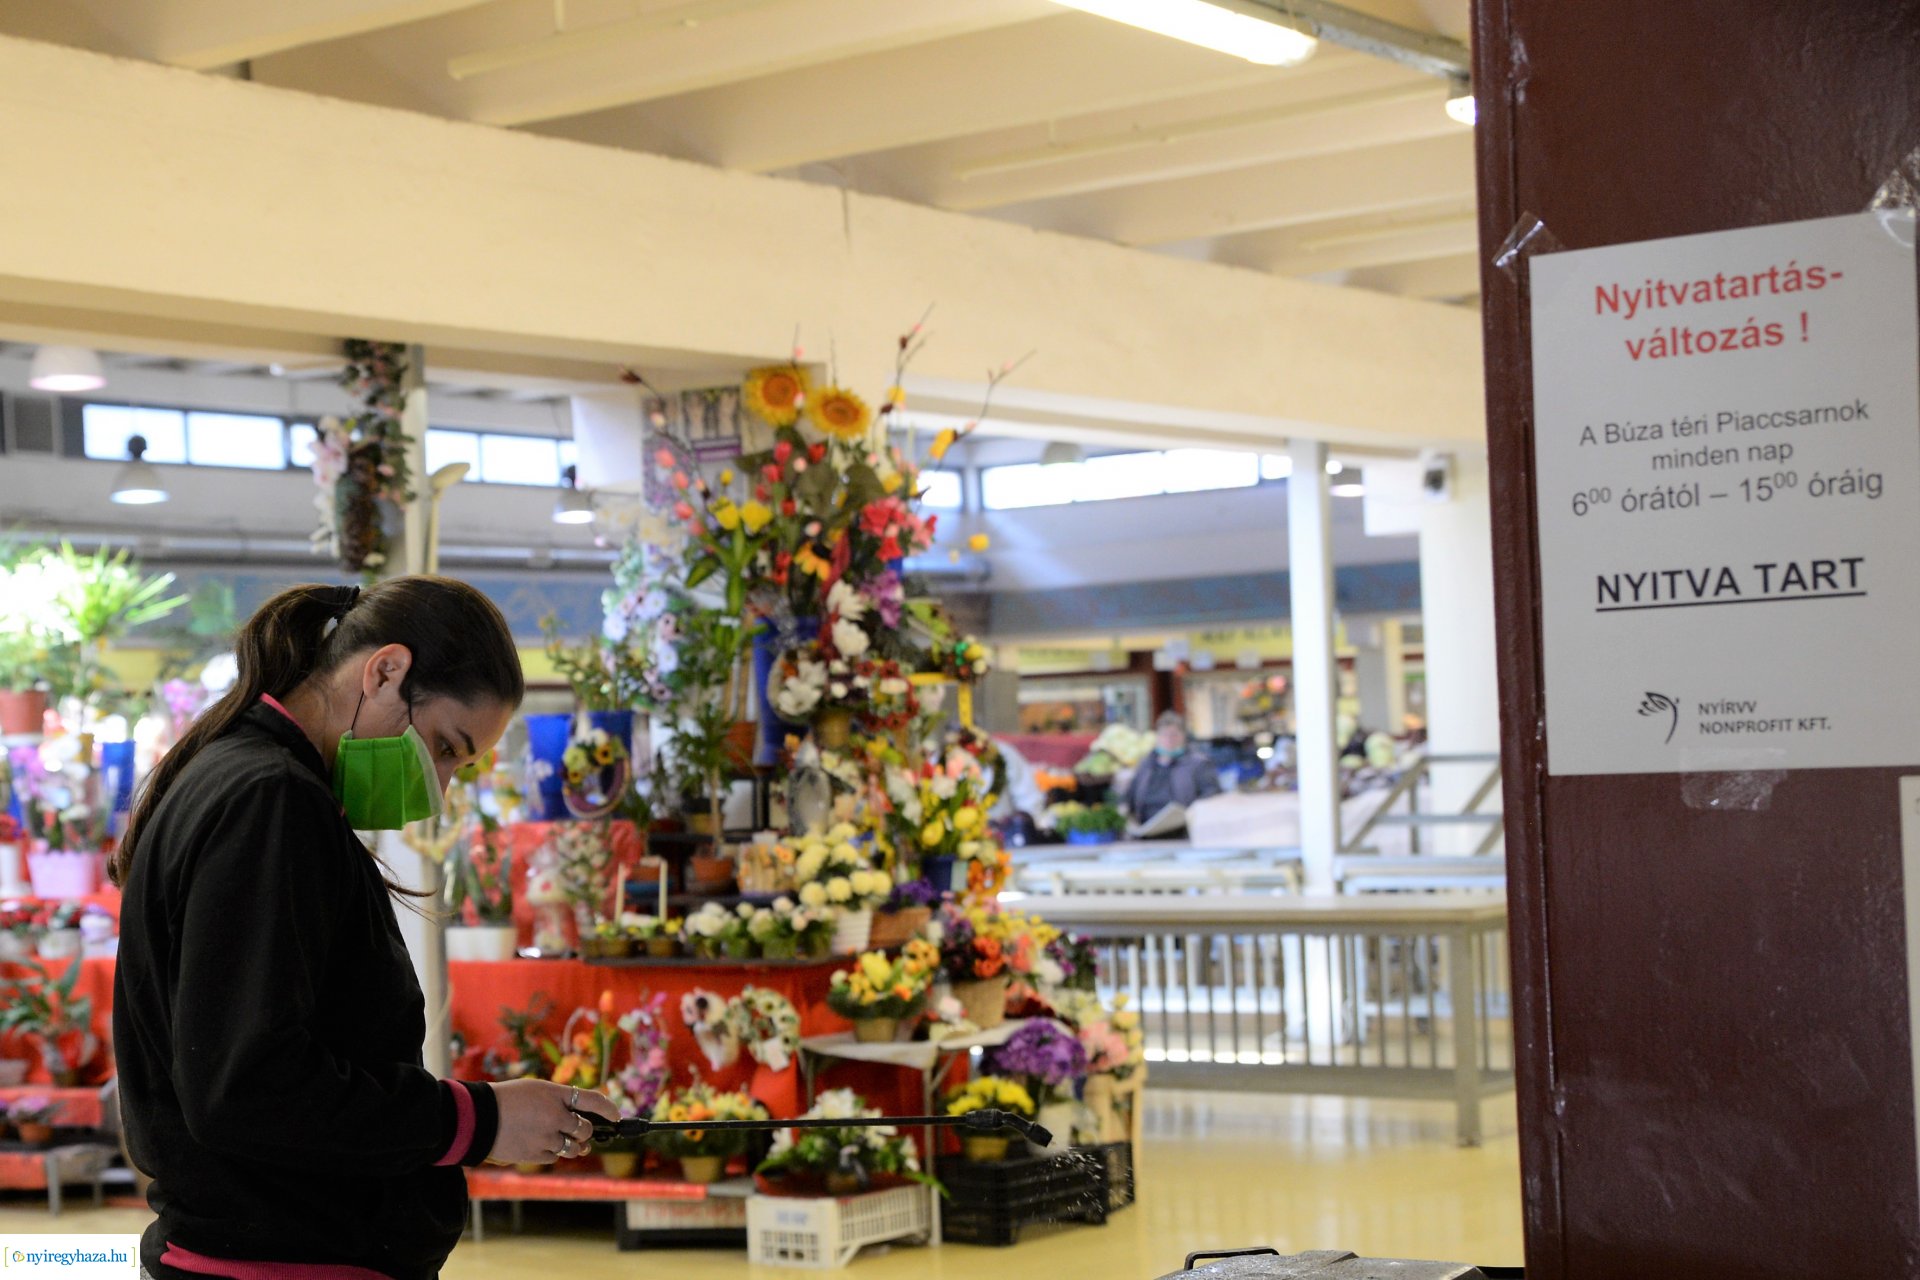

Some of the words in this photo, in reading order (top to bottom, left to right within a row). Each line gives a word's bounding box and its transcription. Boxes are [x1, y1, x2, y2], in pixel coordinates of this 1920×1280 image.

[1595, 260, 1844, 320] Nyitvatartás-
[1625, 317, 1785, 361] változás
[1799, 312, 1810, 342] !
[1579, 426, 1597, 446] A
[1604, 420, 1664, 444] Búza
[1672, 416, 1709, 438] téri
[1716, 399, 1870, 434] Piaccsarnok
[1651, 449, 1740, 471] minden
[1747, 442, 1794, 469] nap
[1620, 484, 1701, 513] órától
[1808, 470, 1884, 499] óráig
[1596, 567, 1741, 605] NYITVA
[1754, 557, 1865, 594] TART
[1699, 719, 1793, 735] NONPROFIT
[1798, 717, 1832, 732] KFT.
